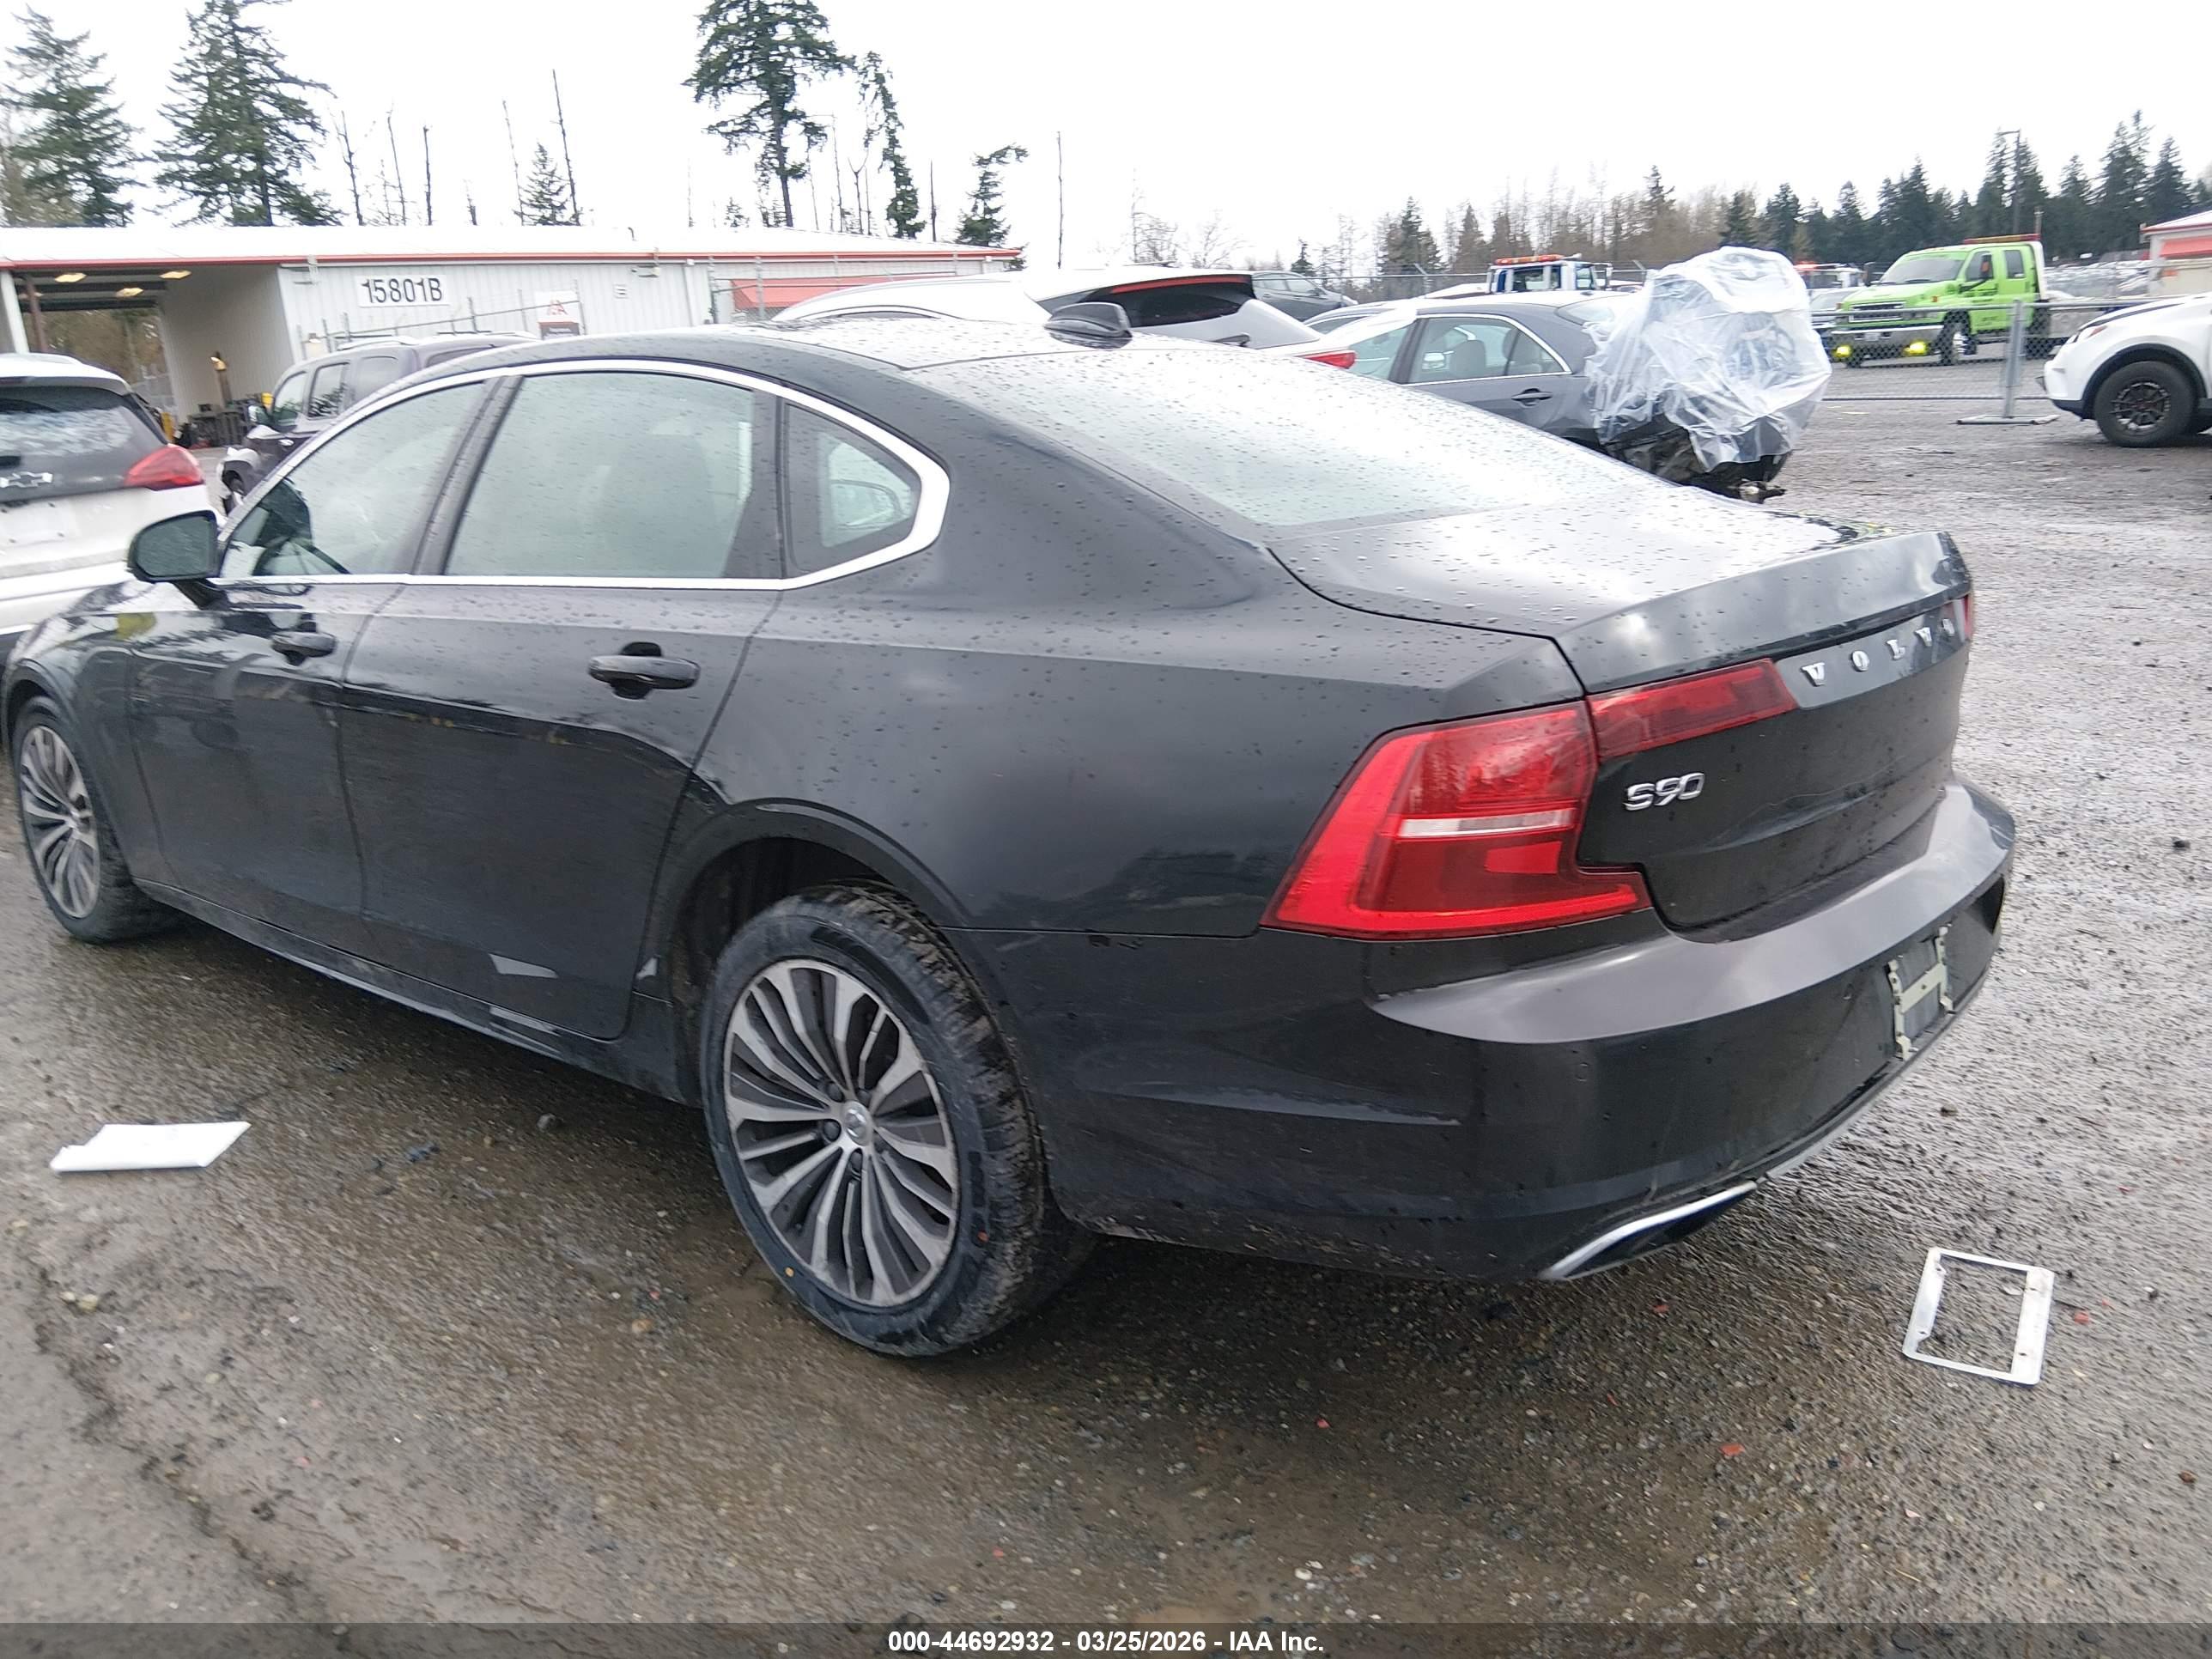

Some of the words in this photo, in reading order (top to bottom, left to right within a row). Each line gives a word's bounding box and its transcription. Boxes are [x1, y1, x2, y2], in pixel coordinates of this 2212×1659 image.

[361, 277, 442, 303] 15801B
[1801, 618, 1954, 686] VOLVO
[1622, 772, 1705, 811] S90
